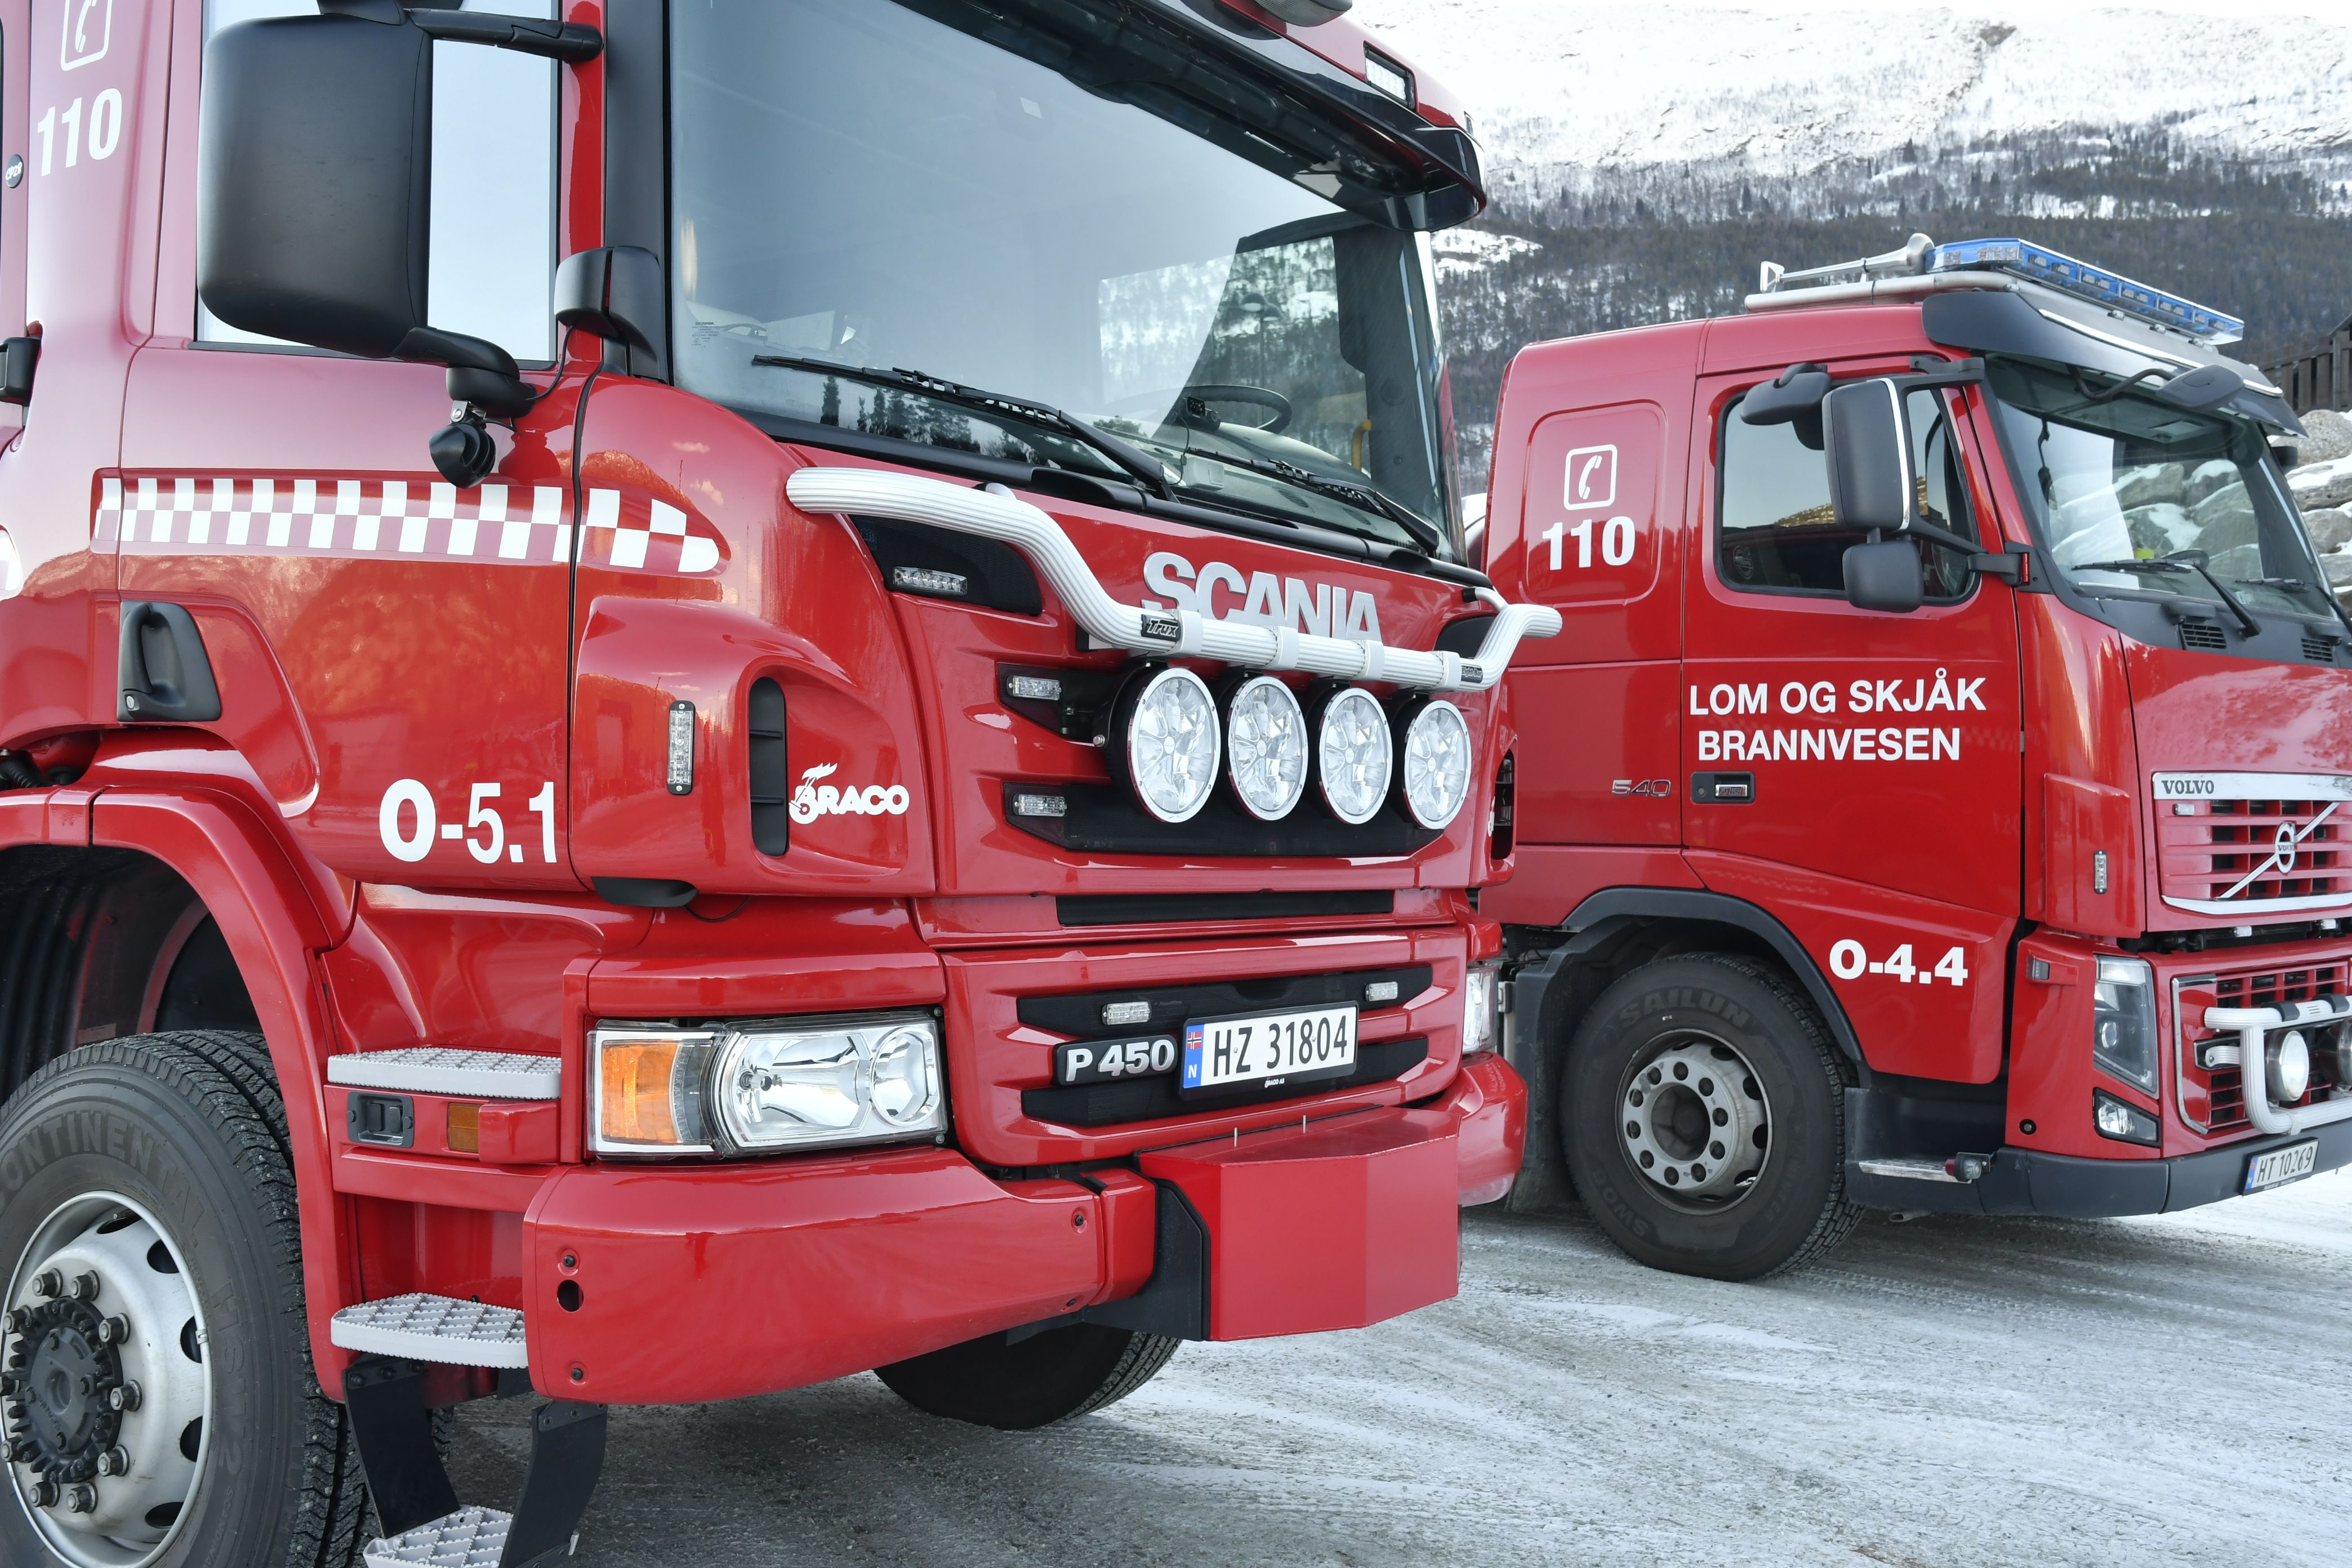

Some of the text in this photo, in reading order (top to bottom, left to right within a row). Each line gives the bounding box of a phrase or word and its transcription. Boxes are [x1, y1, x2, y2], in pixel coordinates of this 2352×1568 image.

[37, 88, 122, 176] 110
[1542, 516, 1636, 571] 110
[1141, 551, 1382, 642] SCANIA
[1147, 618, 1179, 638] Trux
[1690, 667, 1986, 715] LOM OG SKJÅK
[1698, 728, 1961, 761] BRANNVESEN
[1611, 779, 1671, 797] 540
[2162, 780, 2214, 794] VOLVO
[1619, 988, 1750, 1028] SAILUN
[1066, 1039, 1175, 1081] P 450
[1213, 1015, 1347, 1077] HZ 31804
[1188, 1064, 1197, 1079] N
[0, 1111, 204, 1248] ONTINENTAL
[2257, 1146, 2313, 1183] HT 10269
